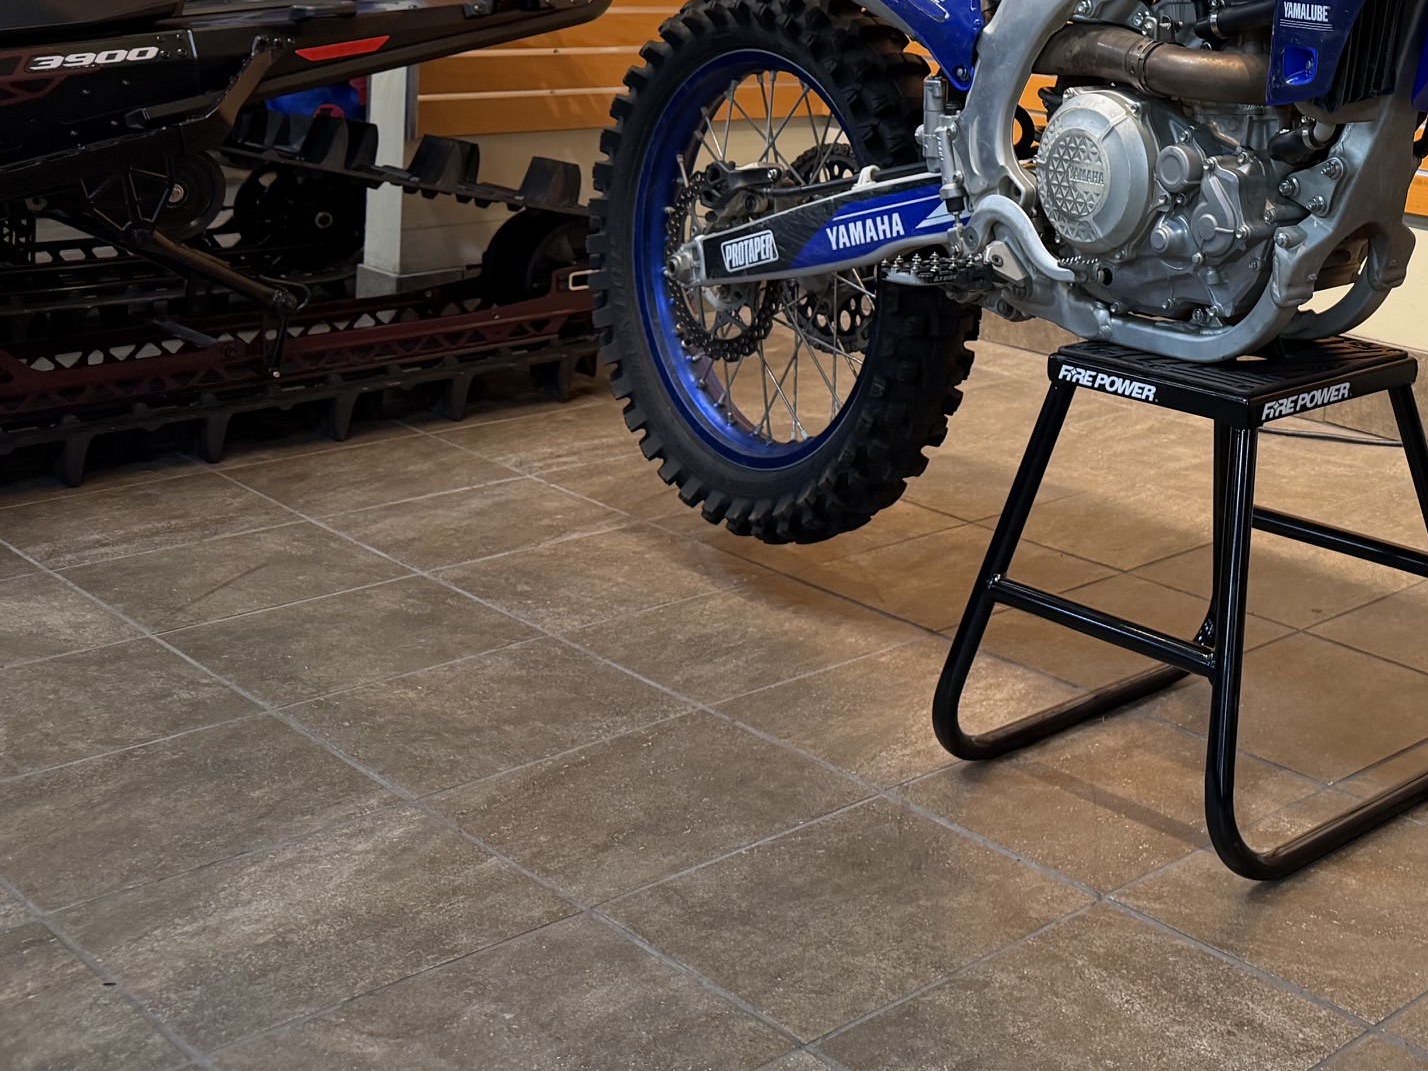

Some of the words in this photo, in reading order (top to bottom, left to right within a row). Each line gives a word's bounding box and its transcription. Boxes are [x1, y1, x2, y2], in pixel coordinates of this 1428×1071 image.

[1284, 1, 1329, 22] YAMALUBE
[30, 46, 159, 70] 3900
[1069, 167, 1104, 186] YAMAHA
[826, 213, 904, 250] YAMAHA
[725, 234, 775, 267] PROTAPER
[1058, 364, 1097, 388] FIRE
[1096, 371, 1157, 402] POWER
[1261, 395, 1295, 421] FIRE
[1296, 382, 1350, 411] POWER
